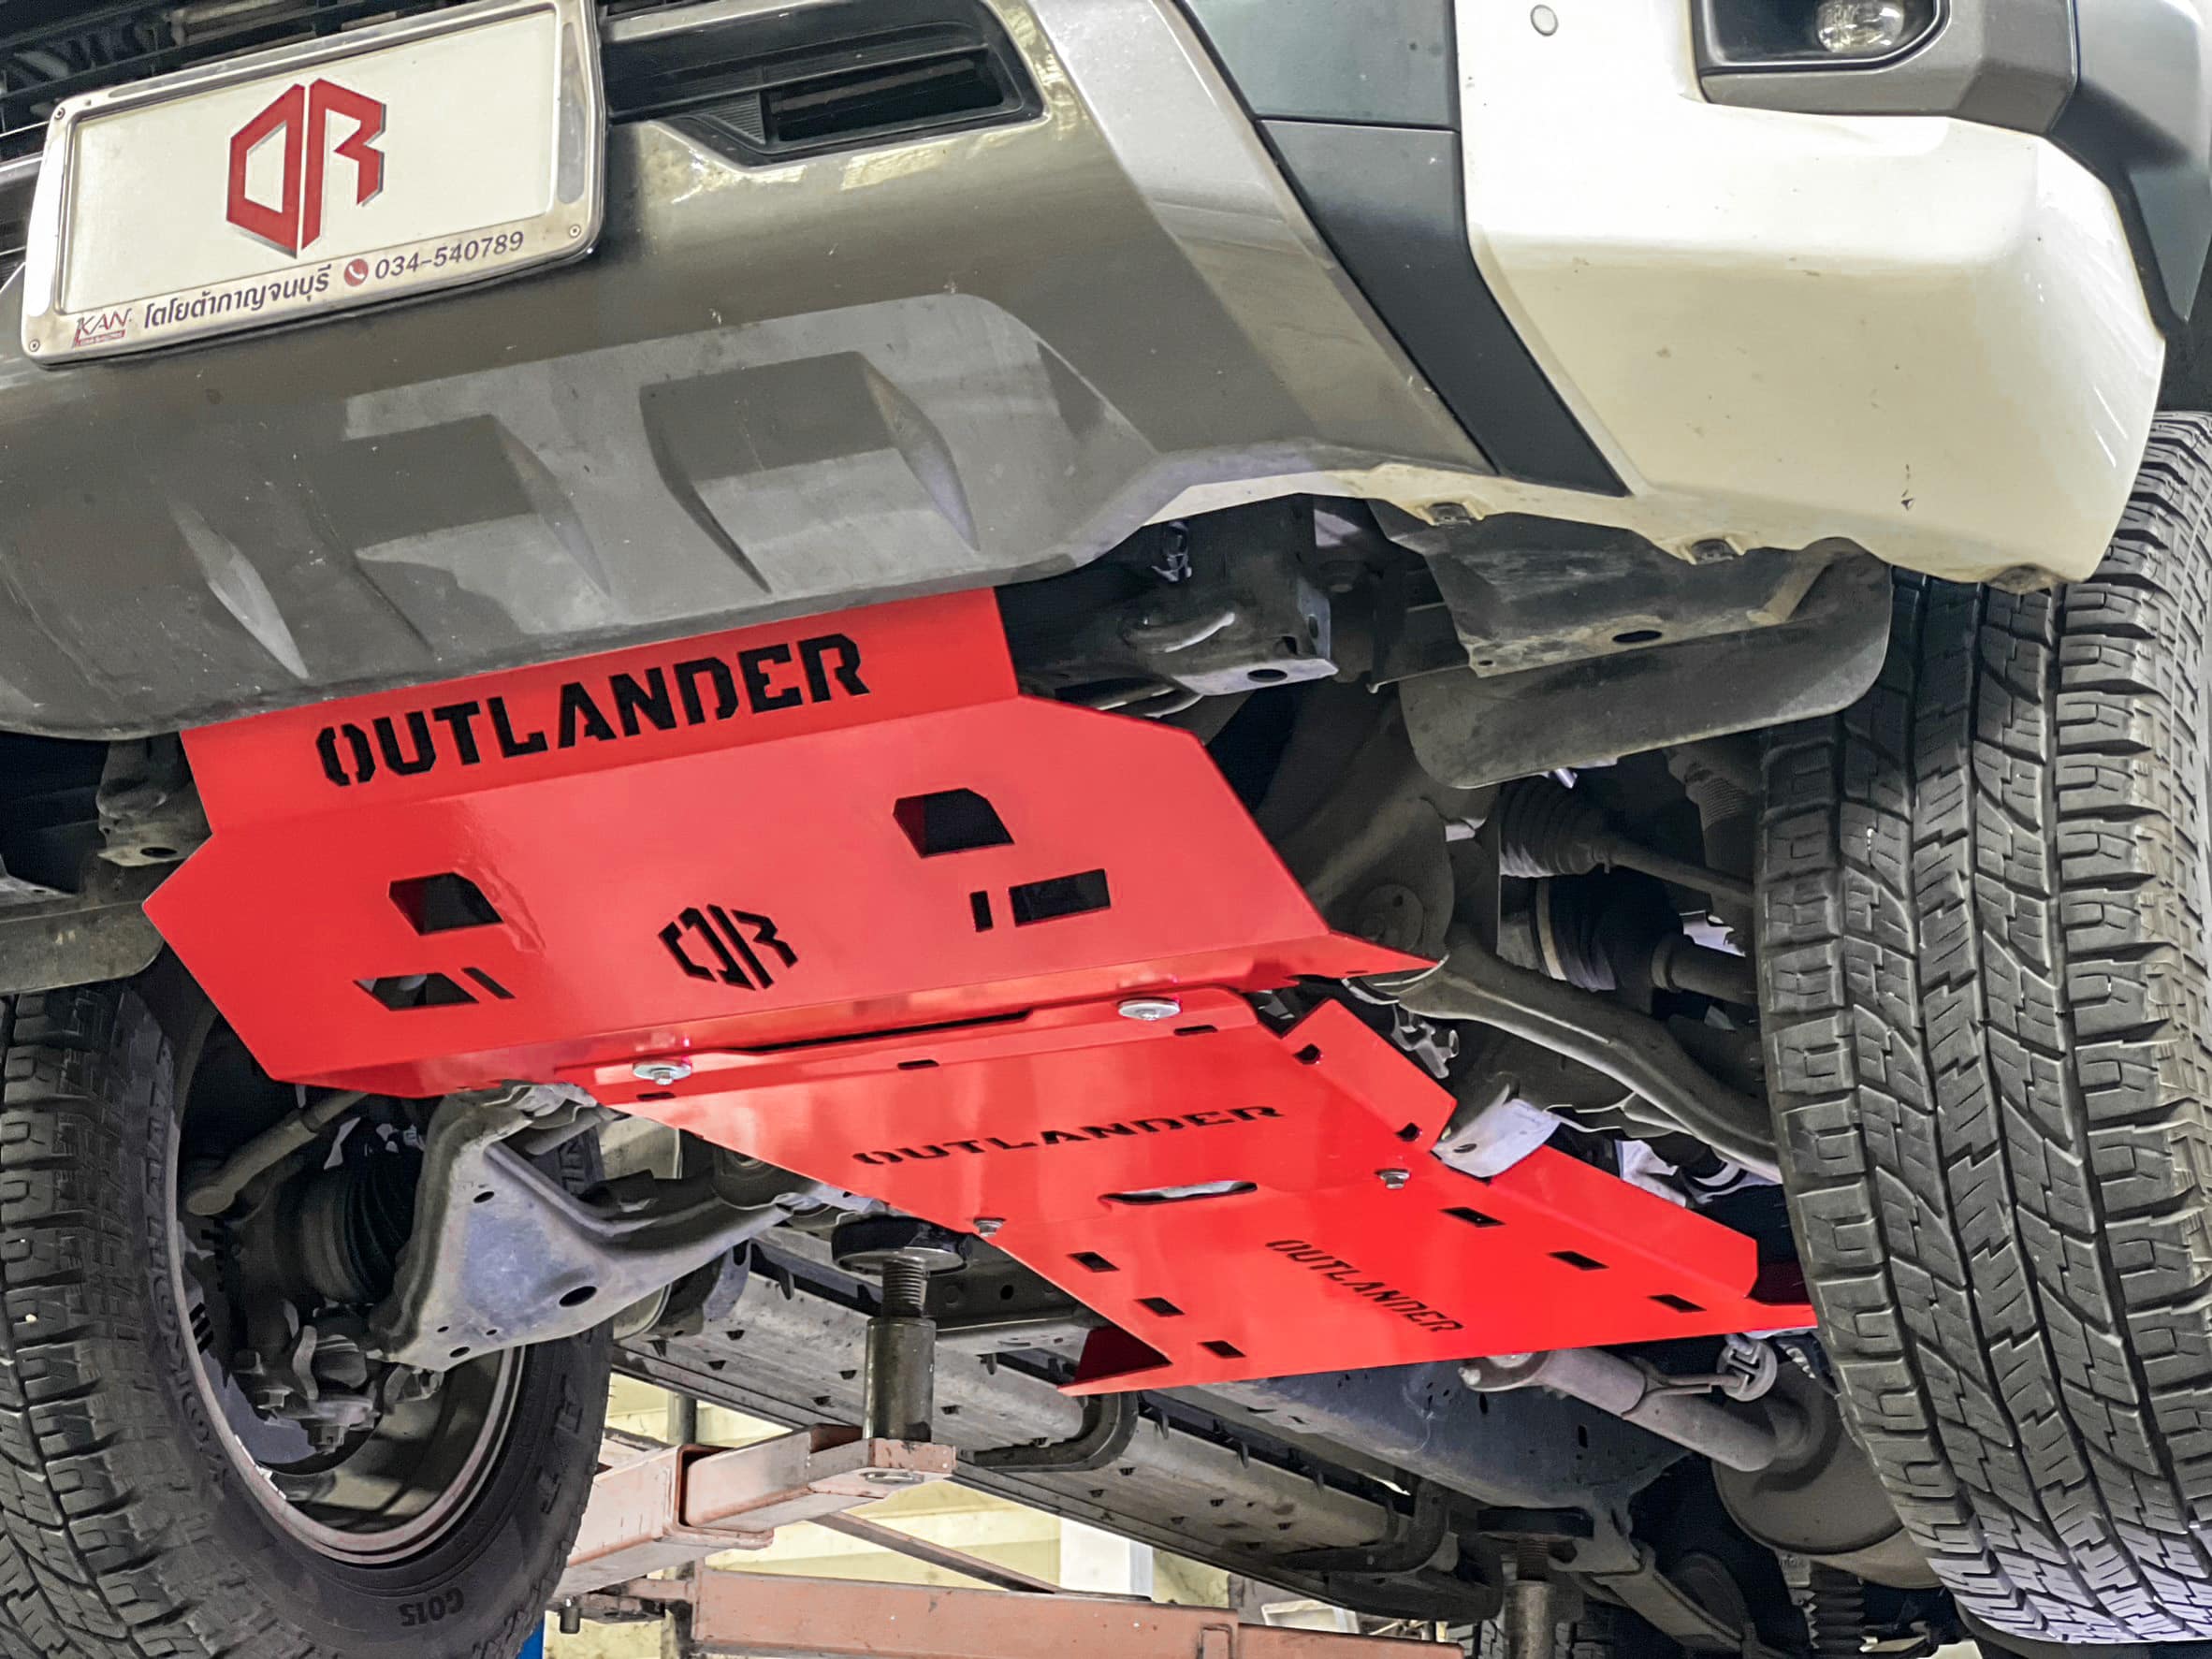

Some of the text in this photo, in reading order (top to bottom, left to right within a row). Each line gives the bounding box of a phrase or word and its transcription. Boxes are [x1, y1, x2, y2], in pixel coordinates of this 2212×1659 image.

[144, 231, 524, 328] โตโยต้ากาญจนบุรี 034-540789
[315, 633, 871, 787] OUTLANDER
[852, 1105, 1285, 1165] OUTLANDER
[1266, 1240, 1463, 1332] OUTLANDER
